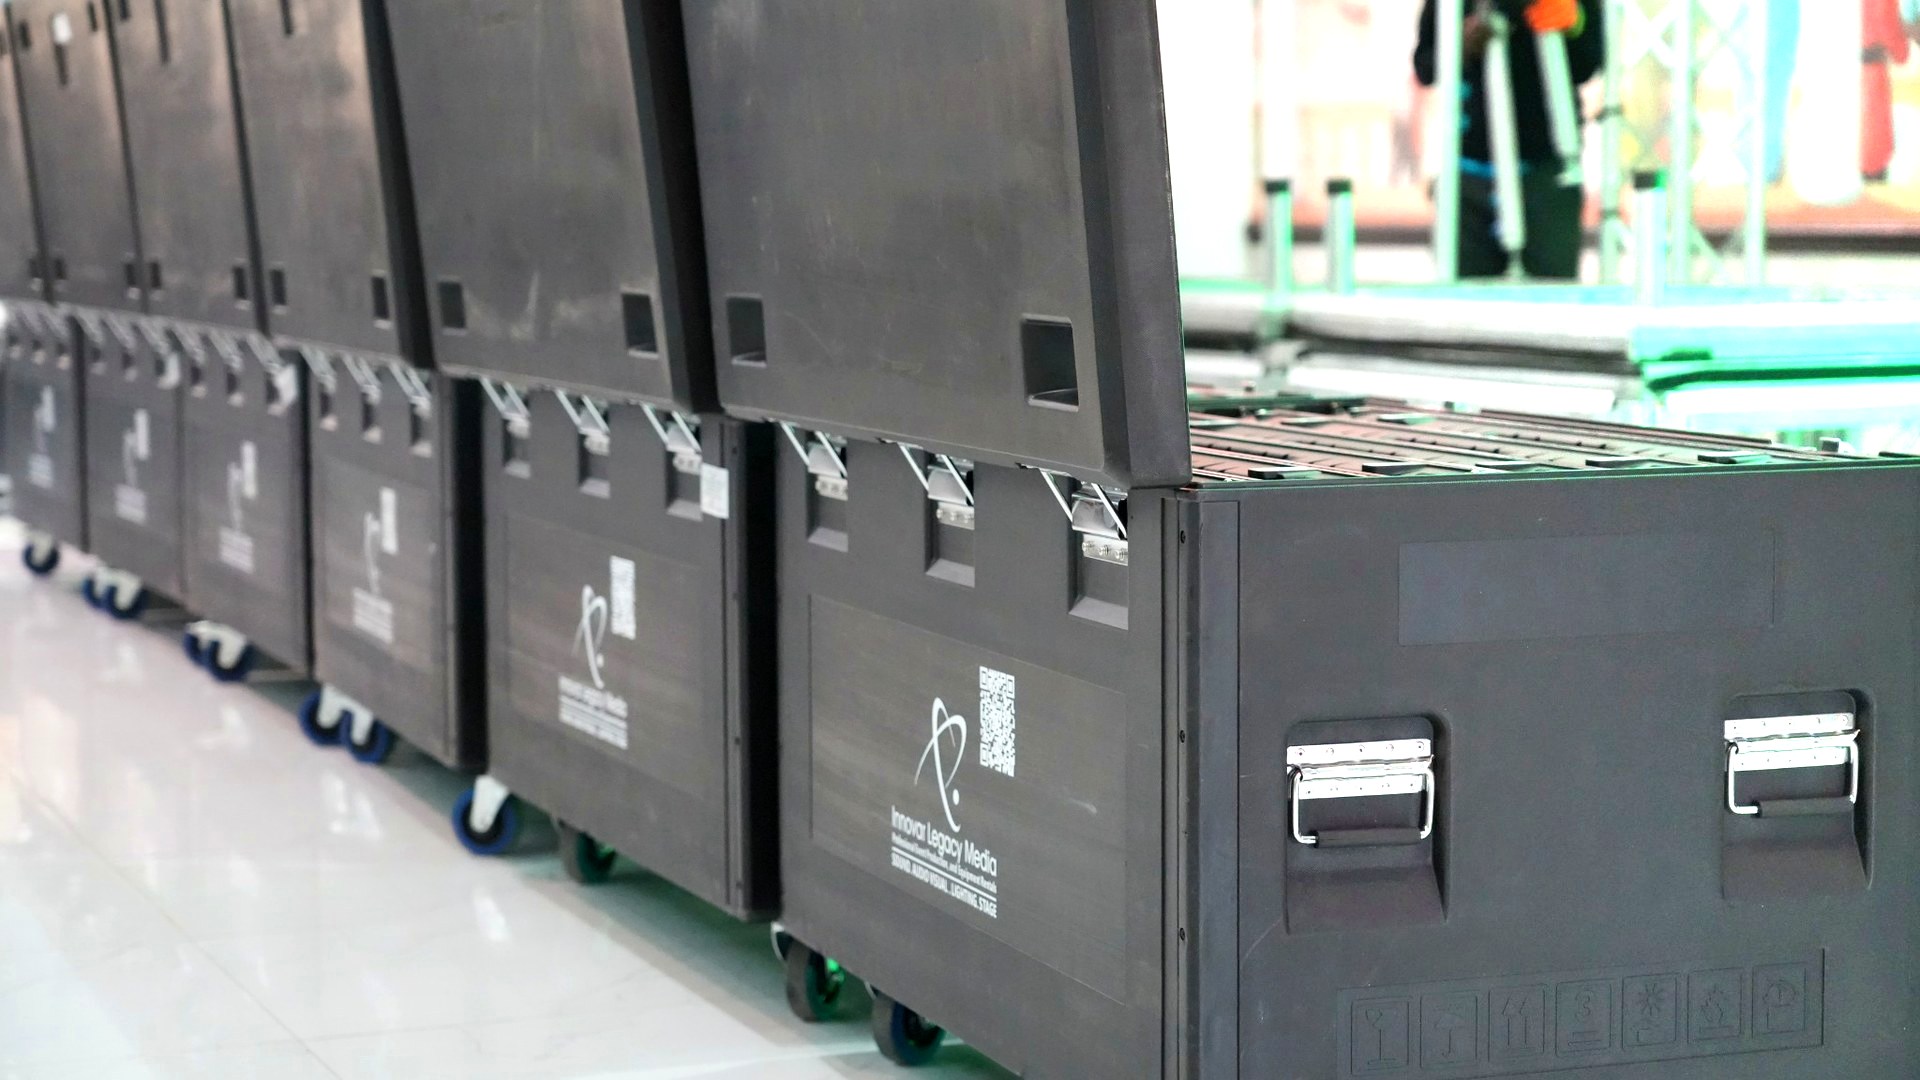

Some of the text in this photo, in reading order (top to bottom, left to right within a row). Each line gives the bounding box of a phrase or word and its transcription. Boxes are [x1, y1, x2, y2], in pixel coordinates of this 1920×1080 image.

[891, 805, 926, 842] Innovar
[927, 821, 963, 863] Legacy
[964, 839, 997, 877] Media
